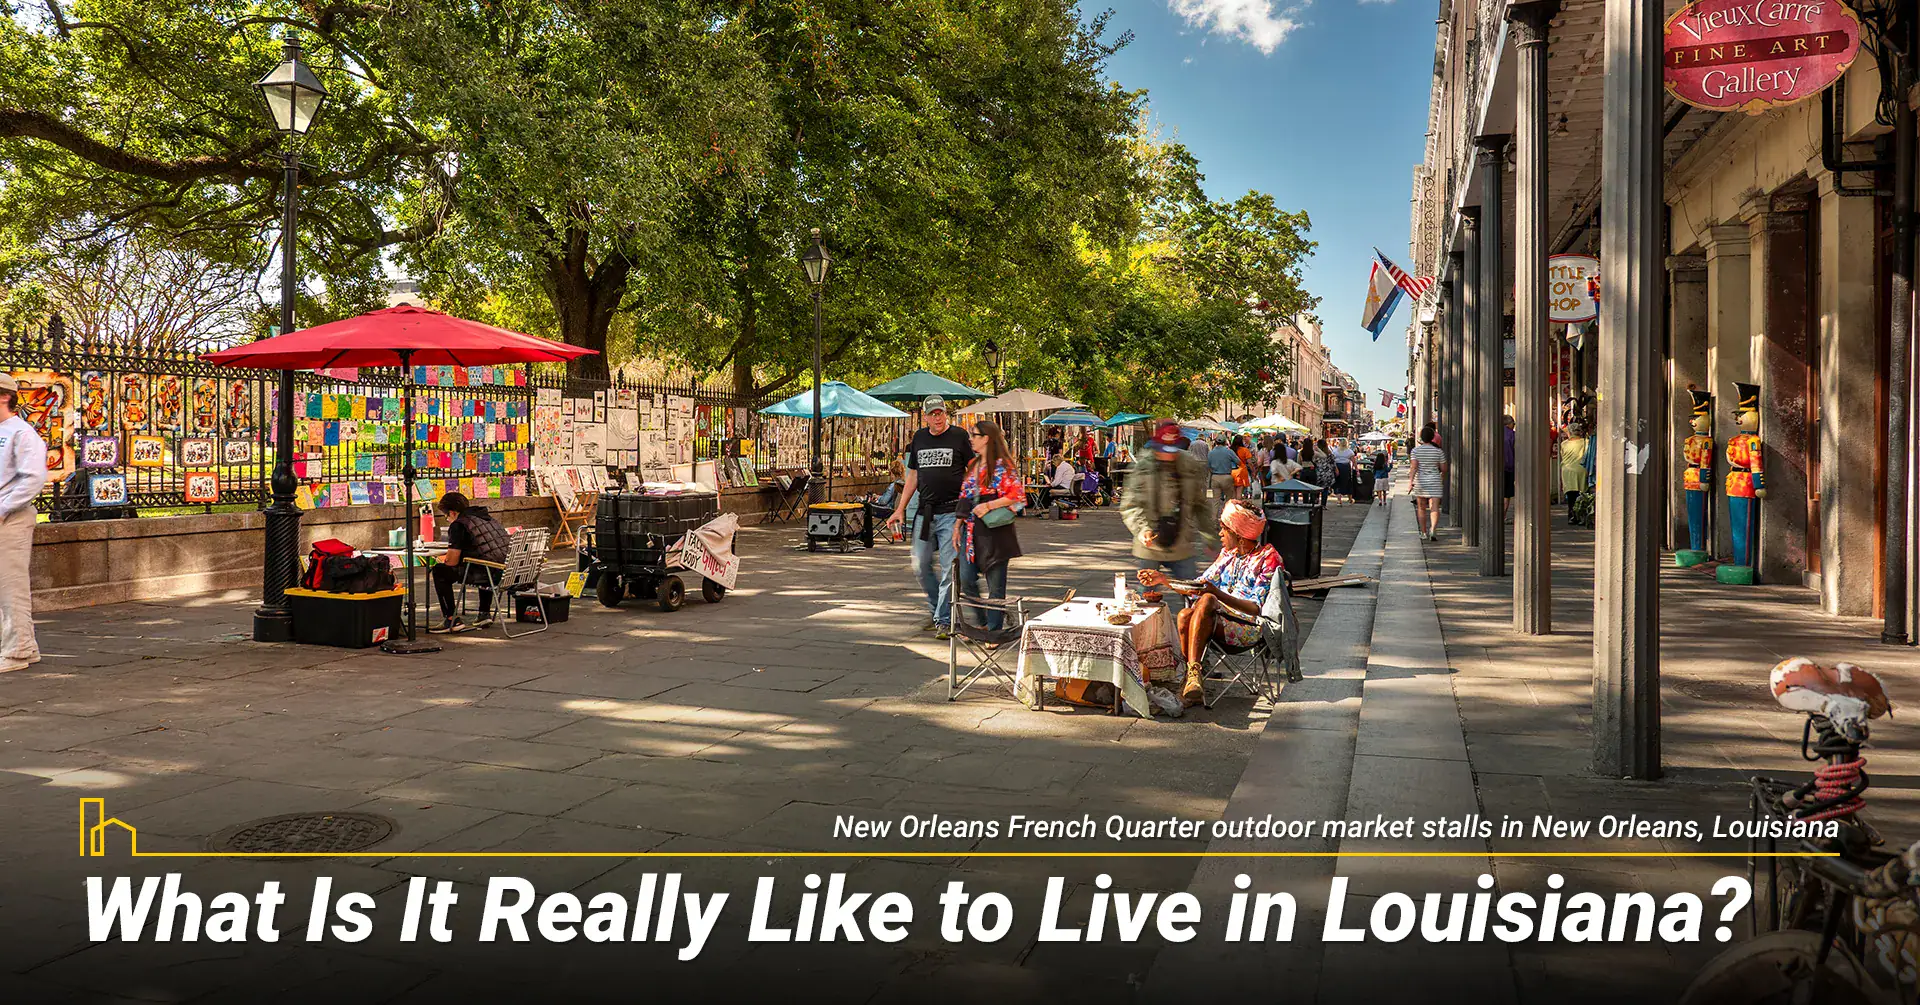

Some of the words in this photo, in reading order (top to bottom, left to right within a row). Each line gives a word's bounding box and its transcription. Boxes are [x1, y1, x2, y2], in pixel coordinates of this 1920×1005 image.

[1677, 4, 1755, 41] Vieux
[1755, 0, 1826, 27] Carré
[1675, 44, 1746, 64] FINE
[1770, 35, 1829, 54] ART
[1702, 66, 1802, 99] Gallery
[683, 550, 701, 569] BODY
